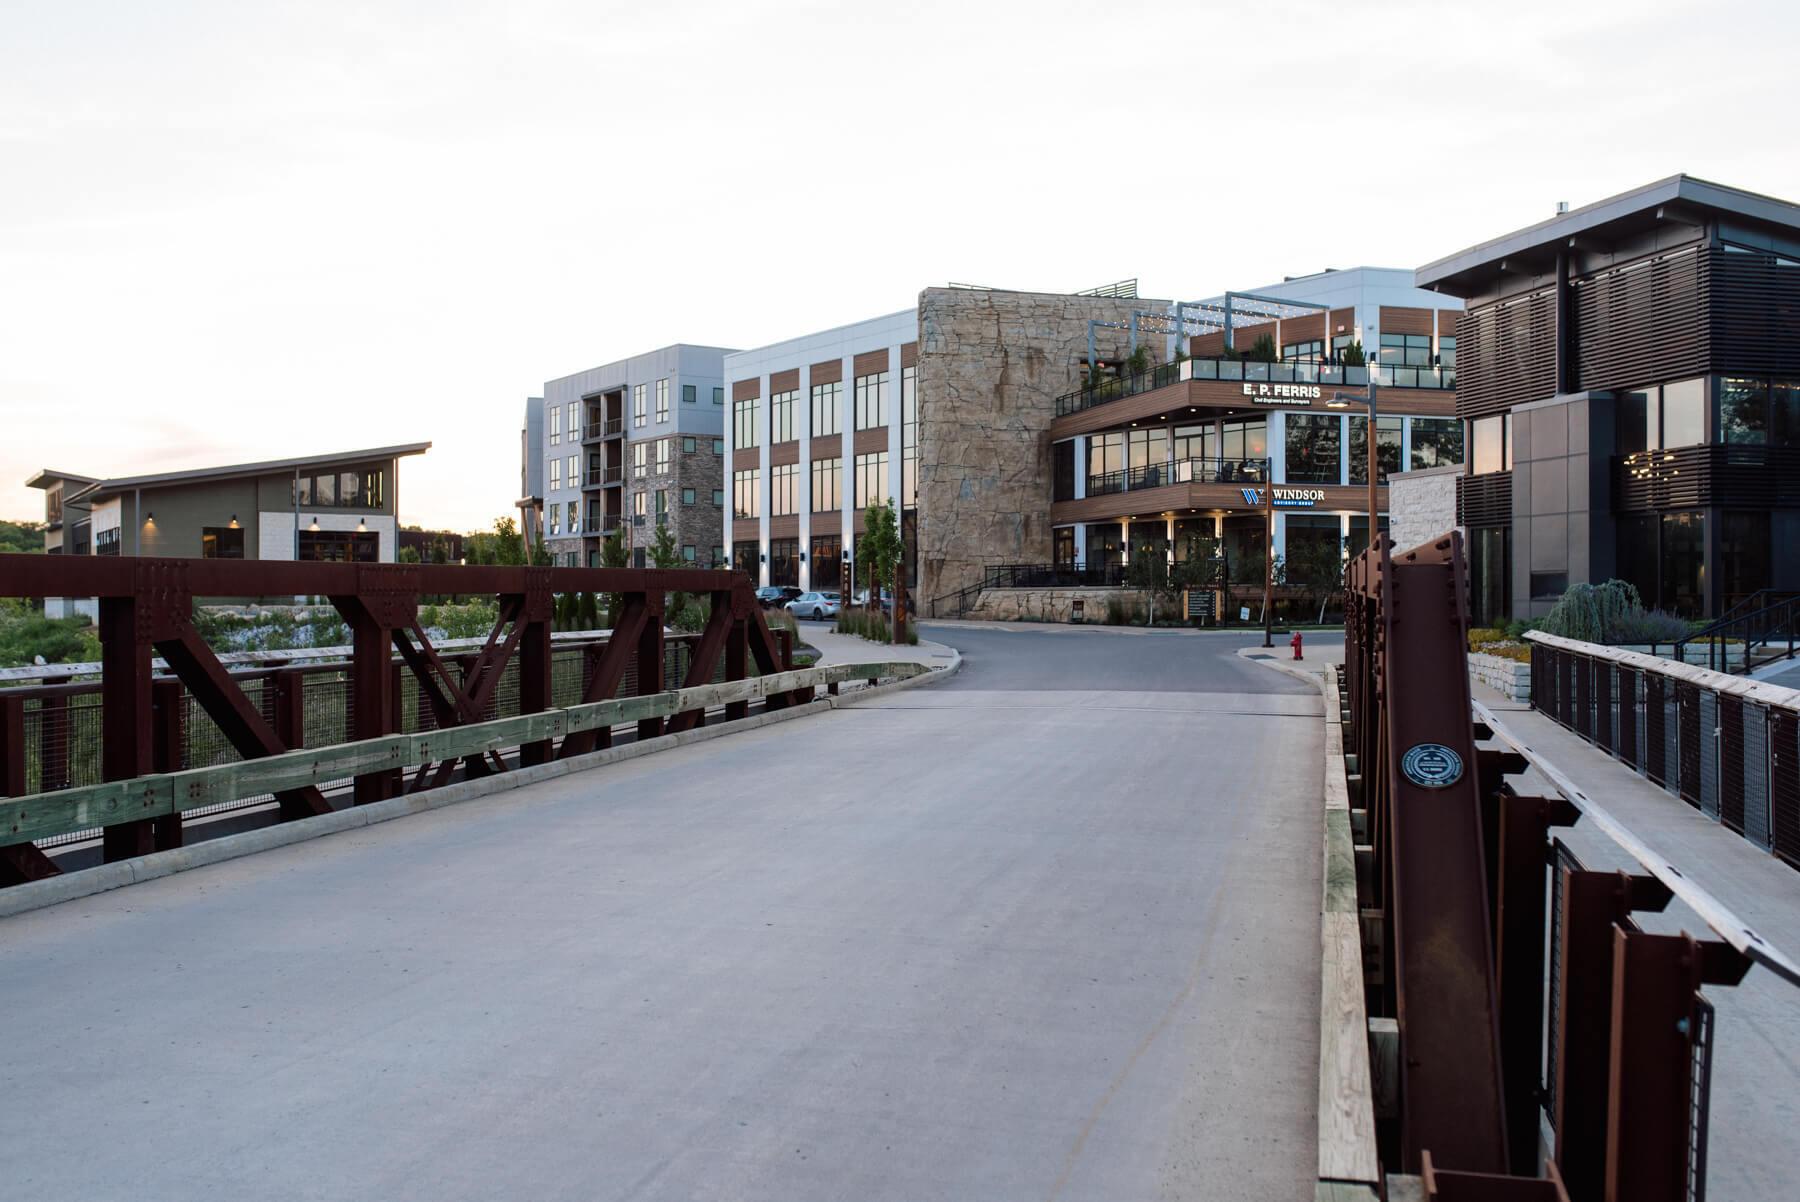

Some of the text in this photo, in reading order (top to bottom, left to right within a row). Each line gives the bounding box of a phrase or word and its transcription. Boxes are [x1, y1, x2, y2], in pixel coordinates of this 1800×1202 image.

[1243, 383, 1321, 398] E. P. FERRIS
[1272, 489, 1325, 501] WINDSOR
